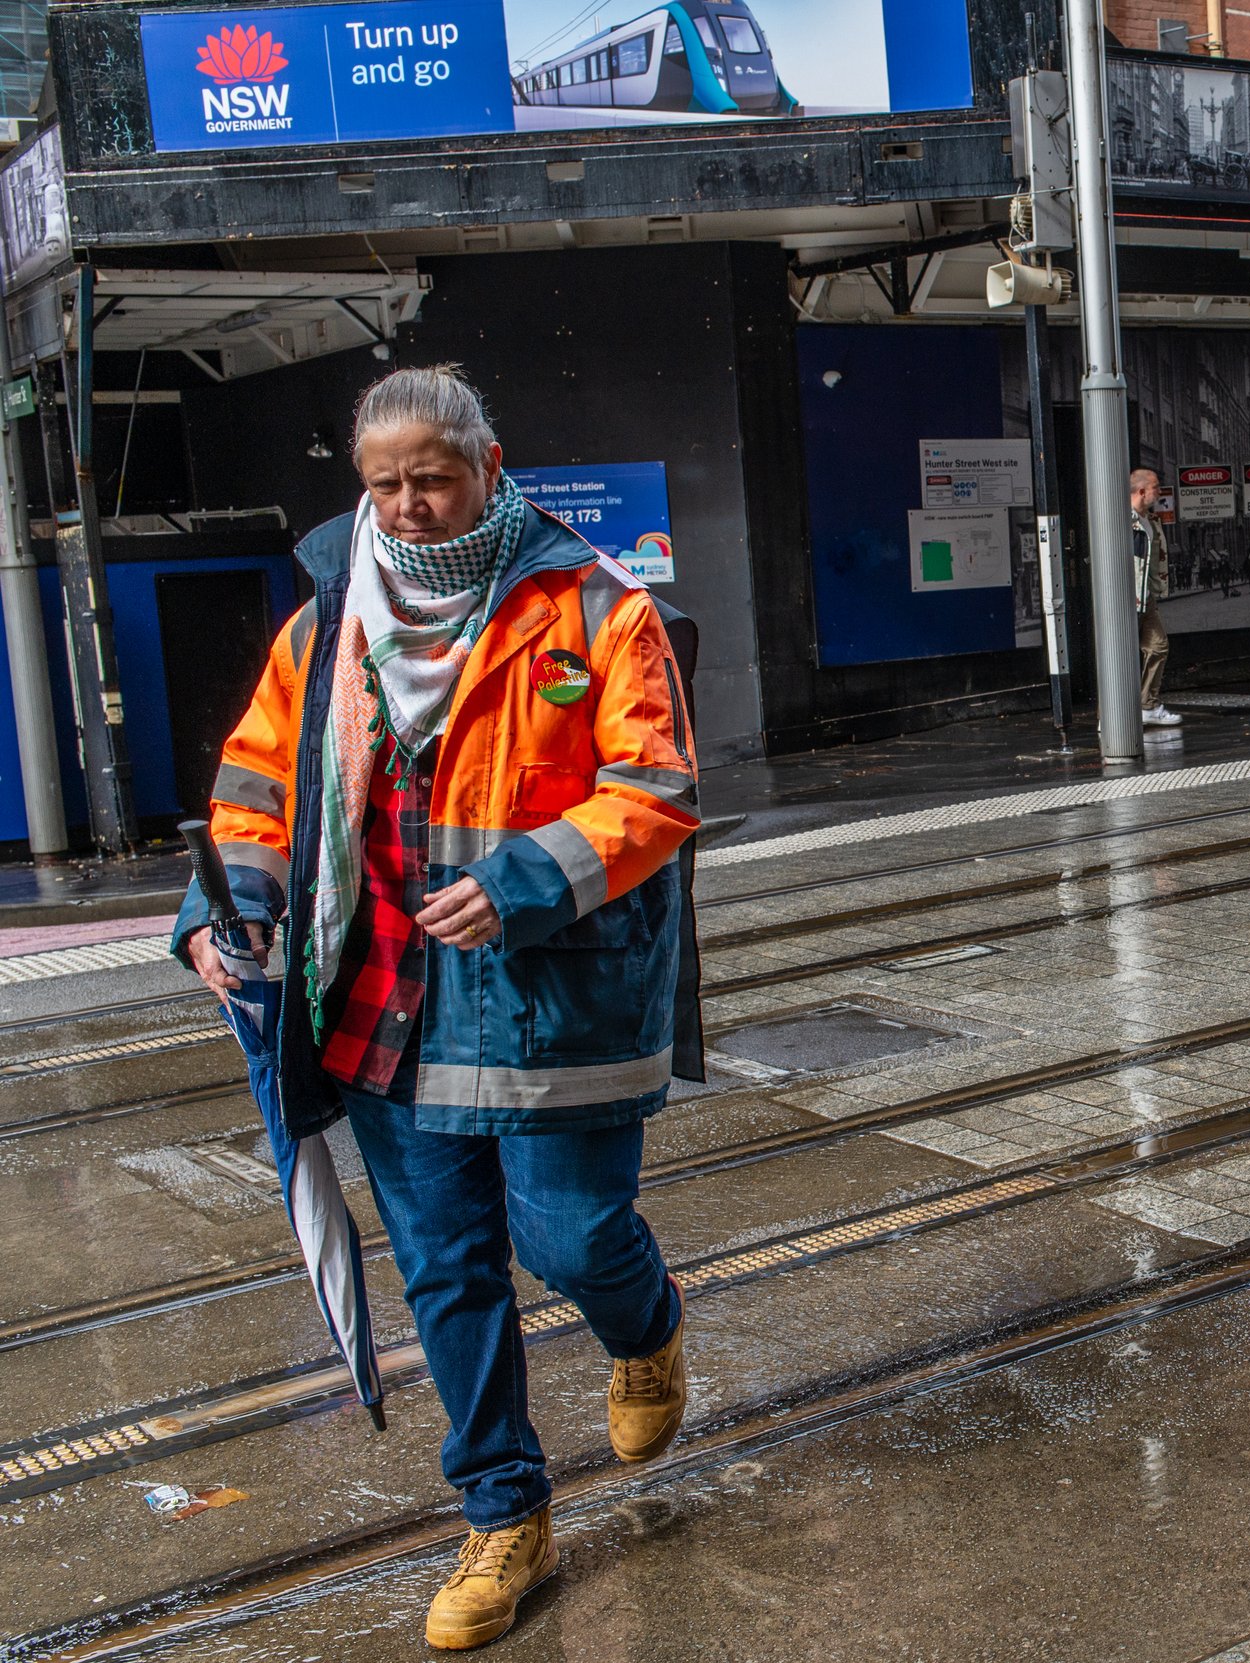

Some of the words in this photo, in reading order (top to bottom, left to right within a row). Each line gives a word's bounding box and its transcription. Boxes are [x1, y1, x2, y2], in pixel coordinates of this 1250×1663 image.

[346, 22, 413, 49] Turn
[422, 23, 459, 49] up
[352, 56, 405, 85] and
[414, 60, 450, 87] go
[202, 84, 290, 121] NSW
[206, 117, 293, 133] GOVERNMENT
[925, 459, 953, 469] Hunter
[954, 458, 981, 468] Street
[982, 458, 1002, 468] West
[1003, 458, 1018, 467] site
[1188, 471, 1223, 482] DANGER
[541, 483, 570, 493] Street
[571, 481, 605, 492] Station
[1180, 487, 1232, 497] CONSTRUCTION
[558, 496, 605, 507] information
[606, 495, 623, 505] line
[1200, 497, 1214, 505] SITE
[576, 508, 602, 523] 173
[646, 569, 667, 577] METRO
[542, 660, 571, 676] Free
[537, 670, 588, 693] Palestine
